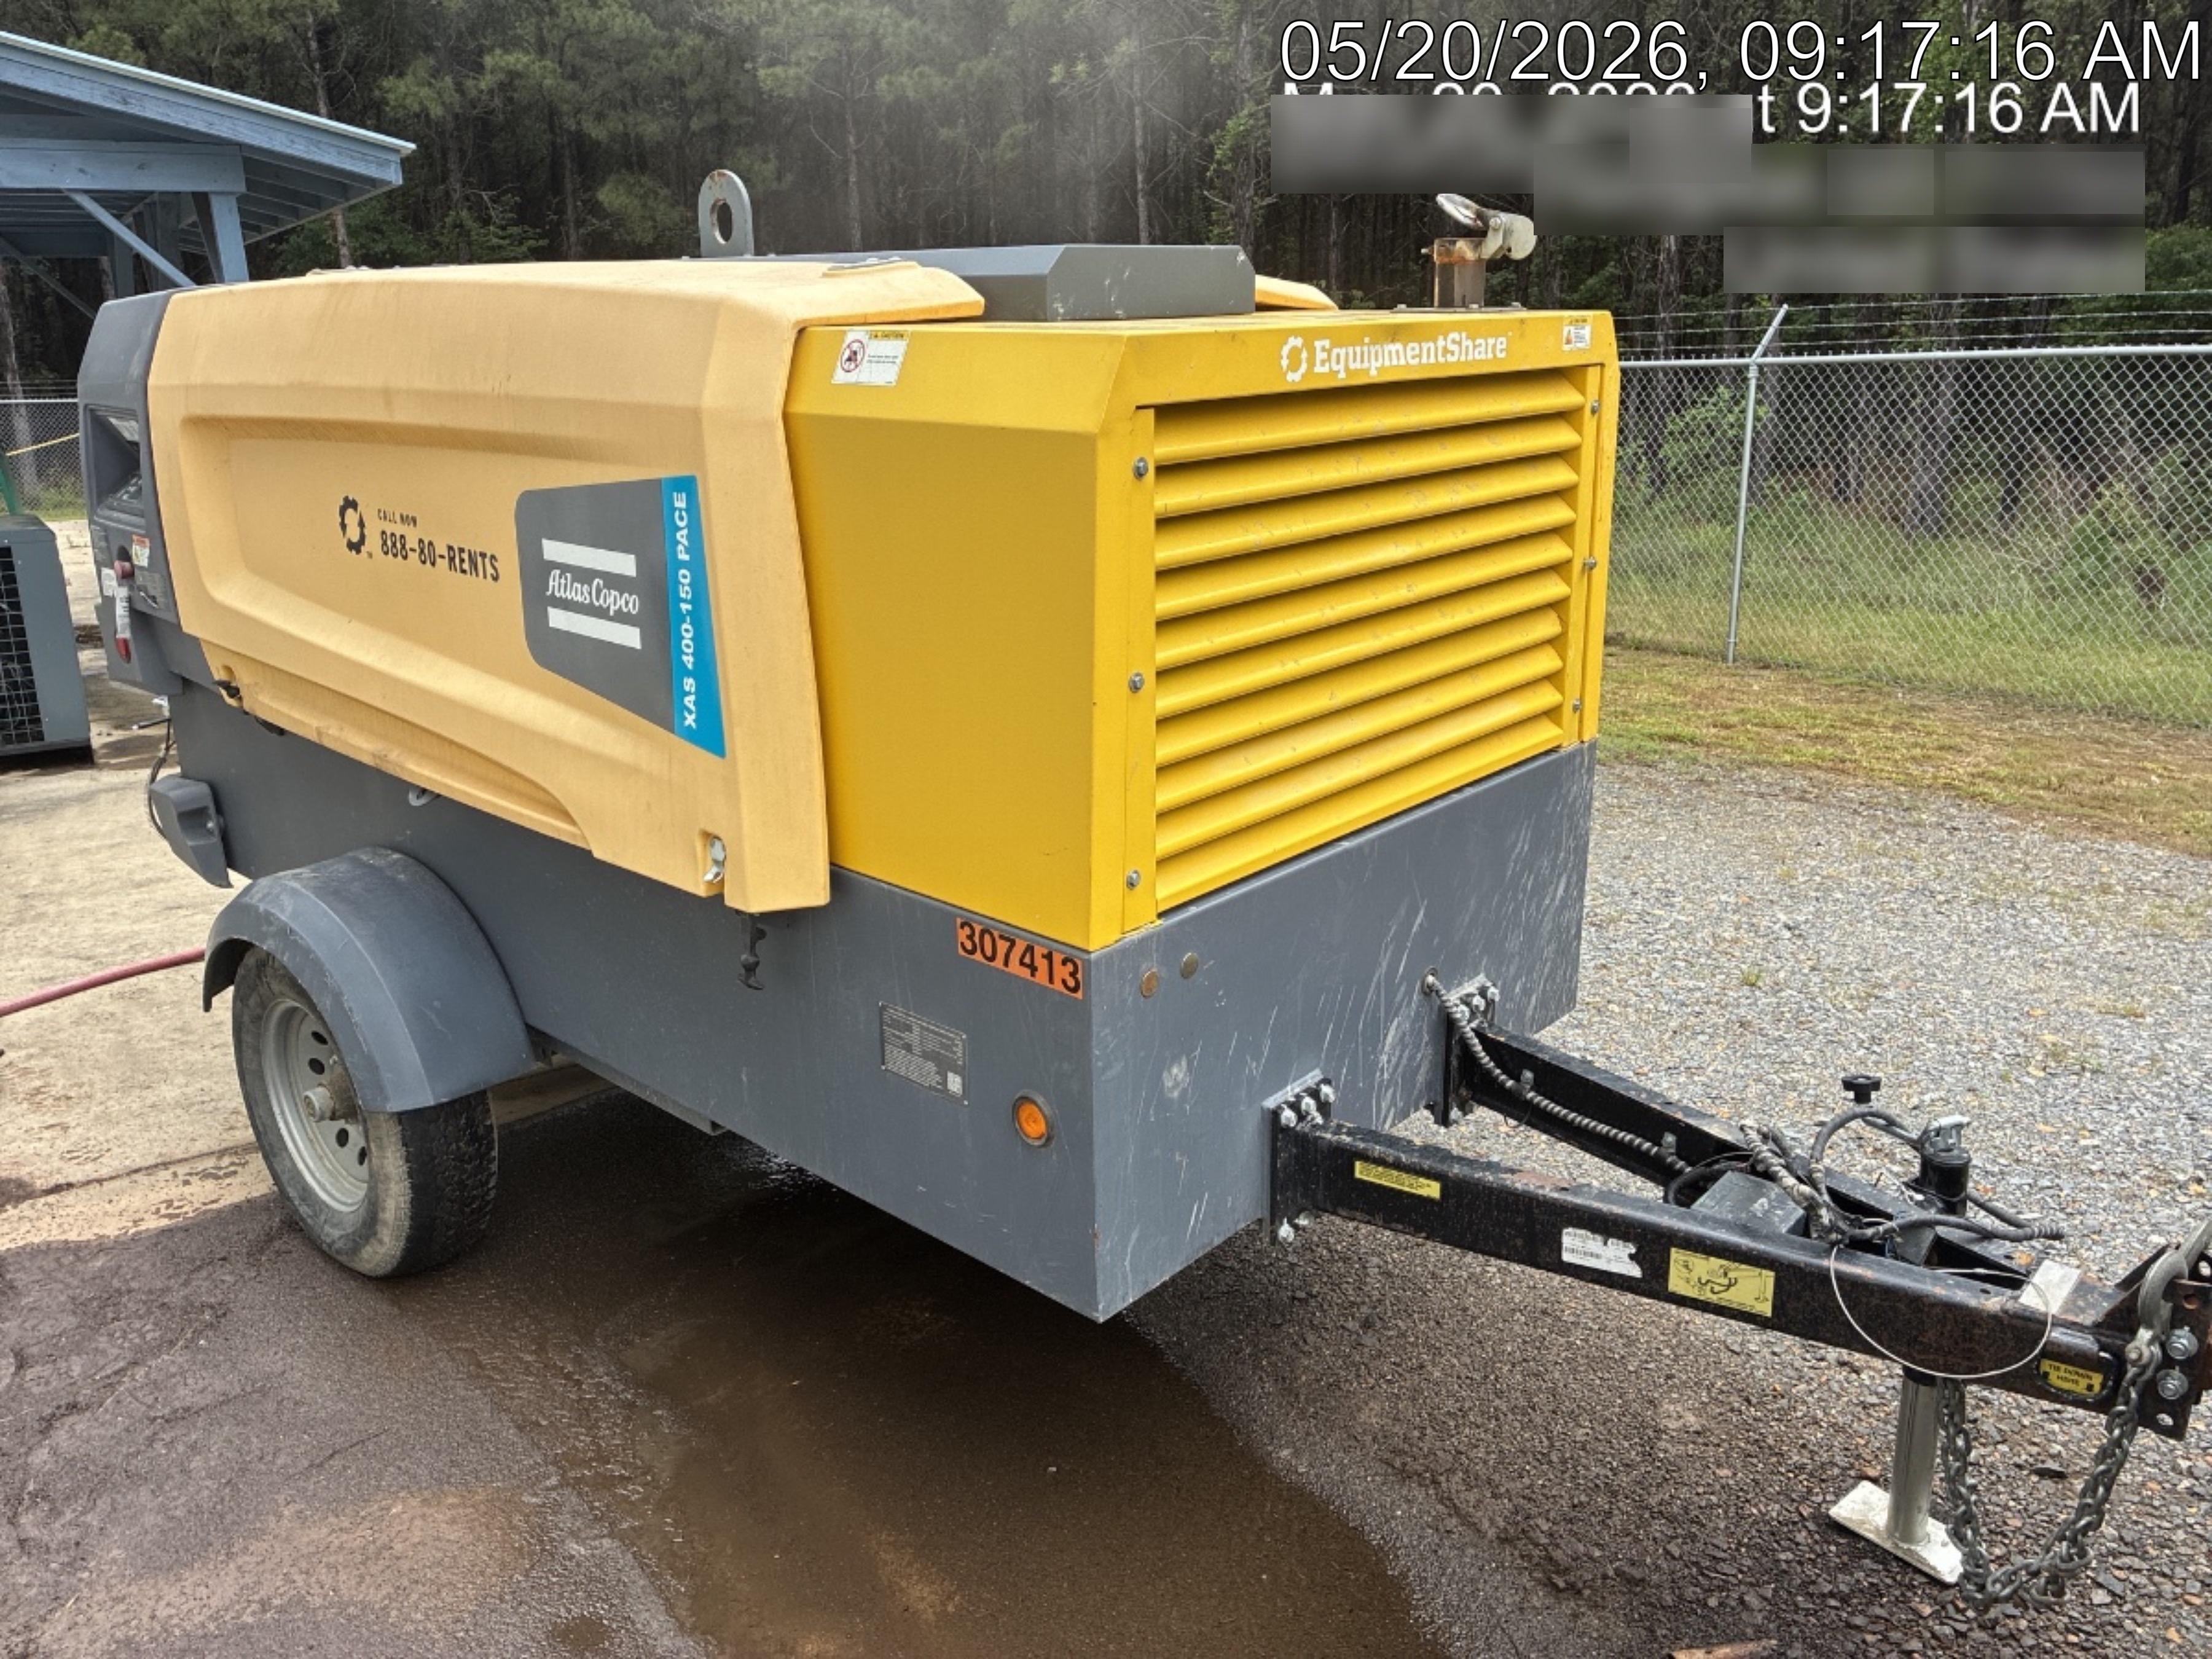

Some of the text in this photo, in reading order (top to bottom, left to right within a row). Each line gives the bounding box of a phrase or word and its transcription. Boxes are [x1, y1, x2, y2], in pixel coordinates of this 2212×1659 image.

[1314, 331, 1507, 379] EquipmentShare
[377, 508, 417, 528] CALL NOW
[380, 530, 500, 583] 888-80-RENTS
[545, 569, 639, 616] Atlas Copco
[672, 492, 697, 730] XAS 400-150 PACE
[959, 920, 1081, 995] 307413
